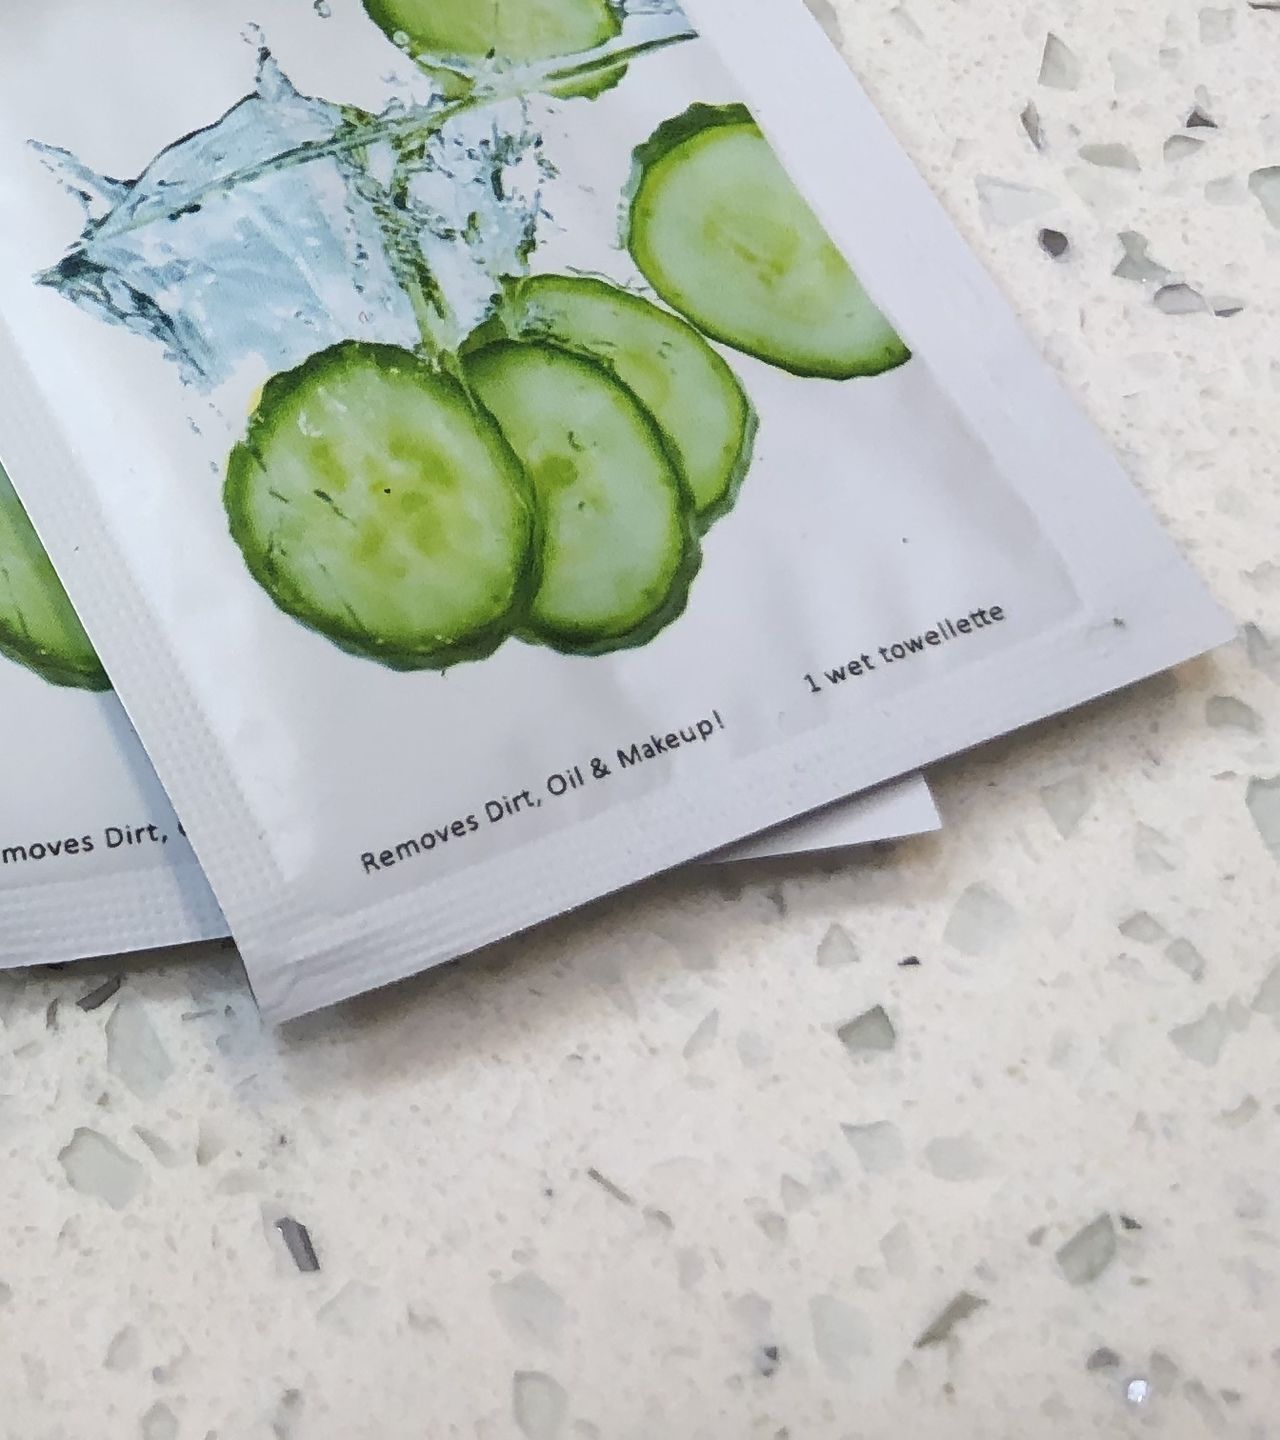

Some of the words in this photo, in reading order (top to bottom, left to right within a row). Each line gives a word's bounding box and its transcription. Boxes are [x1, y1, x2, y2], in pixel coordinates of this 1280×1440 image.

[804, 673, 822, 693] 1
[824, 650, 875, 686] wet
[878, 602, 1006, 660] towellette
[105, 823, 168, 849] Dirt,
[360, 810, 480, 875] Removes
[485, 789, 544, 825] Dirt,
[546, 766, 586, 798] Oil
[590, 757, 612, 780] &
[617, 710, 724, 771] Makeup!
